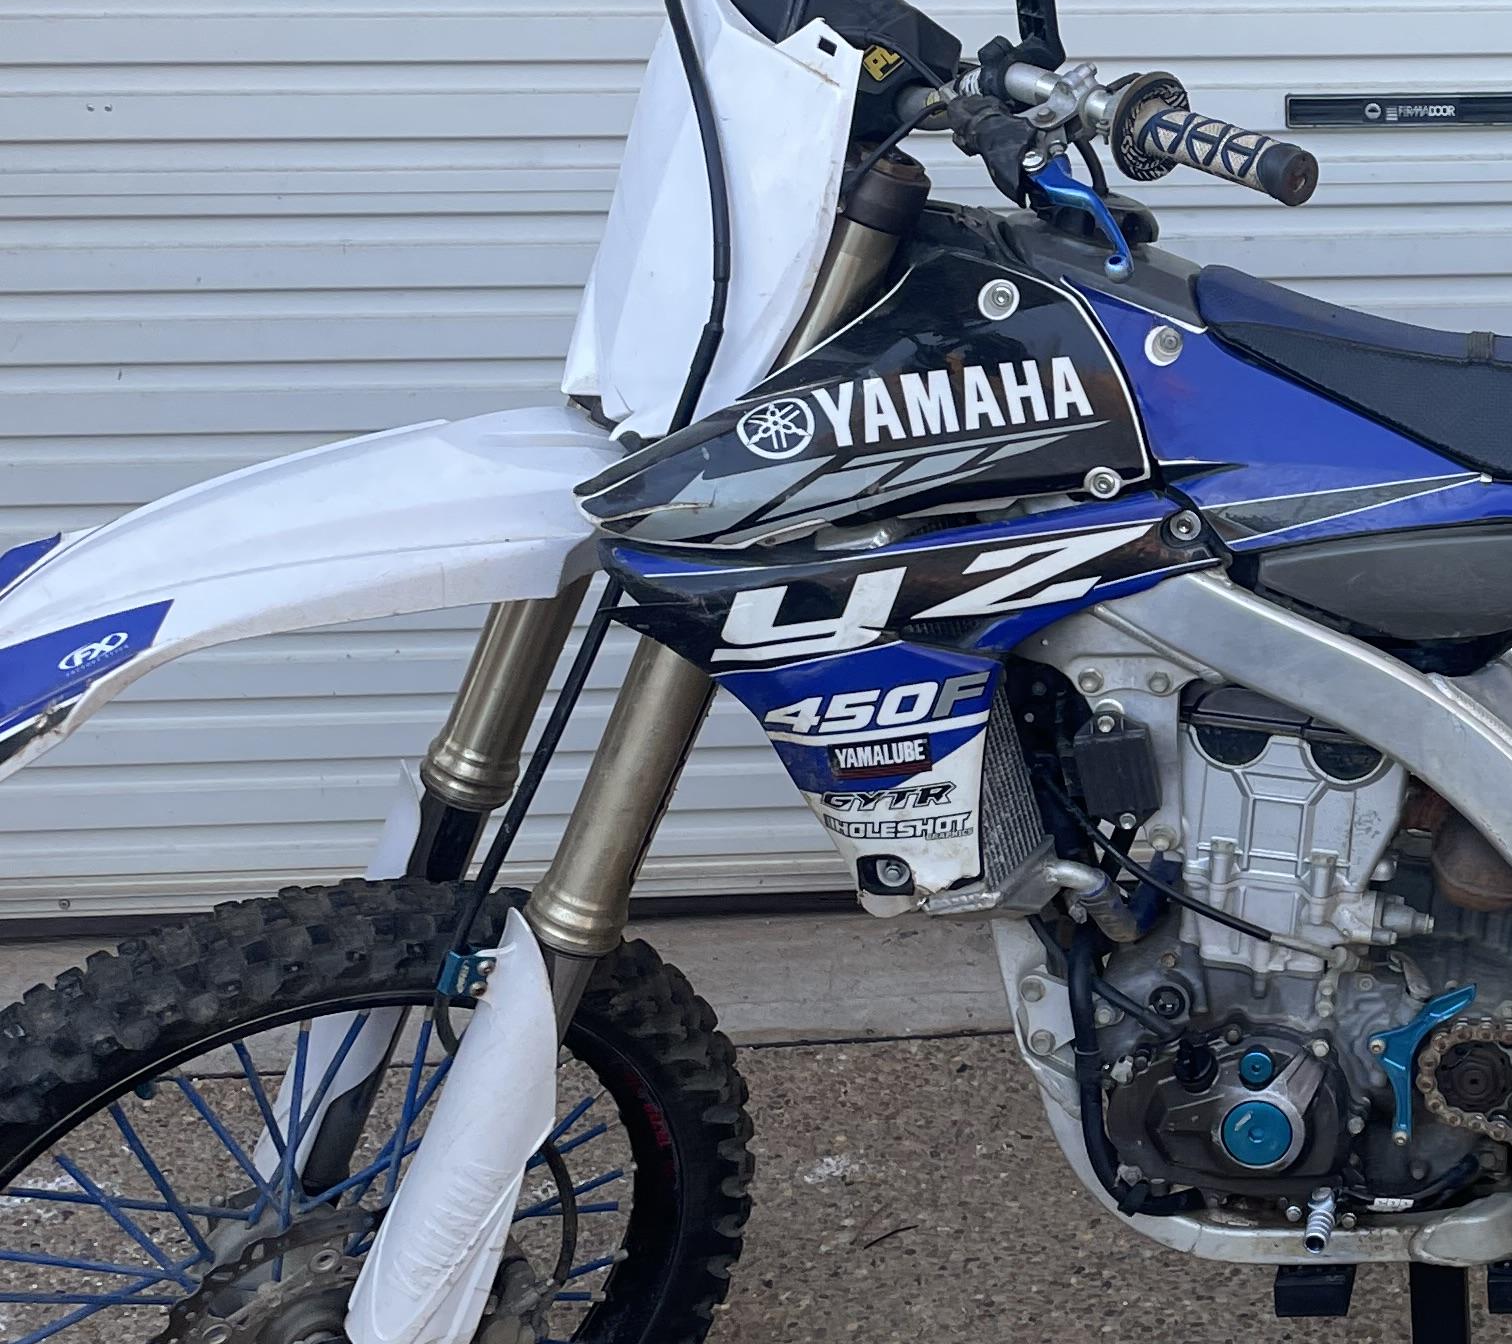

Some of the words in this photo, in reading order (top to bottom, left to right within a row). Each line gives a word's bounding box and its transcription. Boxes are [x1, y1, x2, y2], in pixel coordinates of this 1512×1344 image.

[811, 356, 1095, 448] YAMAHA
[710, 523, 1157, 662] YZ
[764, 672, 990, 733] 450F
[834, 739, 926, 769] YAMALUBE
[821, 781, 957, 812] GYTR
[830, 810, 972, 839] HOLESHOT
